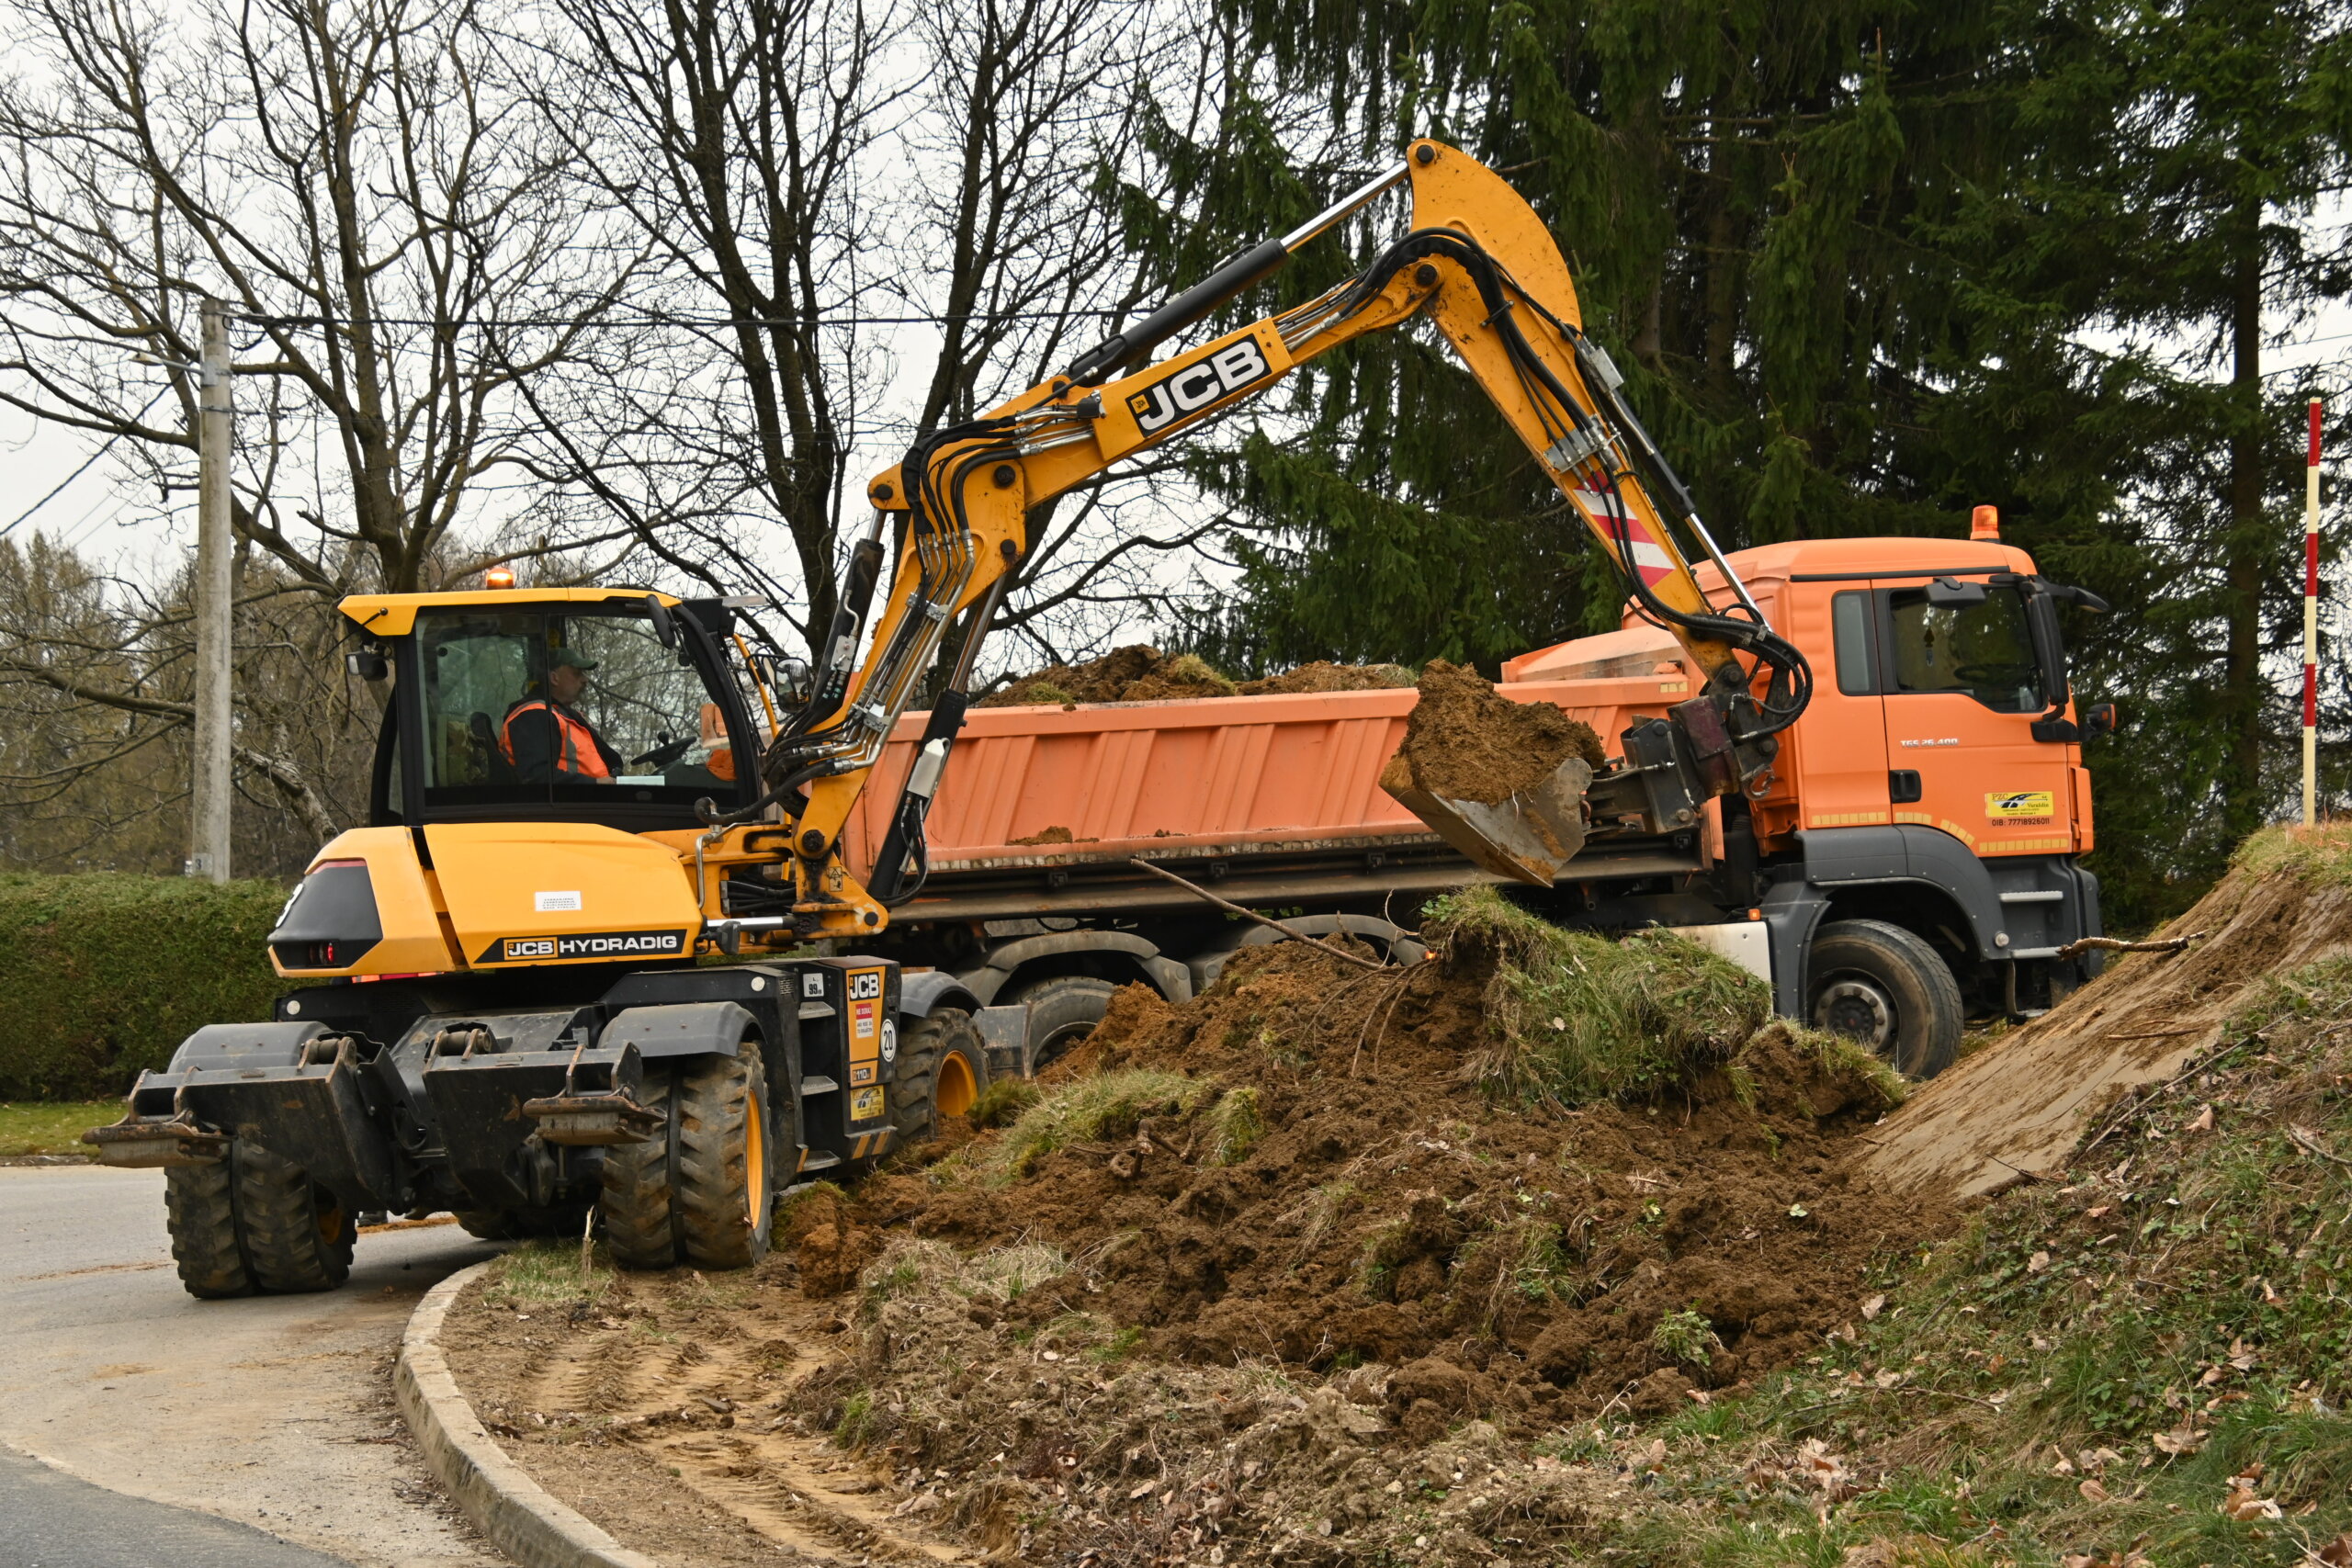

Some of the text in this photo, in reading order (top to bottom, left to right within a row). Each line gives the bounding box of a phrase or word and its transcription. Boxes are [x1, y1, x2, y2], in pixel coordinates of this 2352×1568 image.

[1139, 341, 1265, 431] JCB
[508, 935, 677, 956] JCB HYDRADIG
[850, 974, 879, 999] JCB
[883, 1030, 894, 1052] 20
